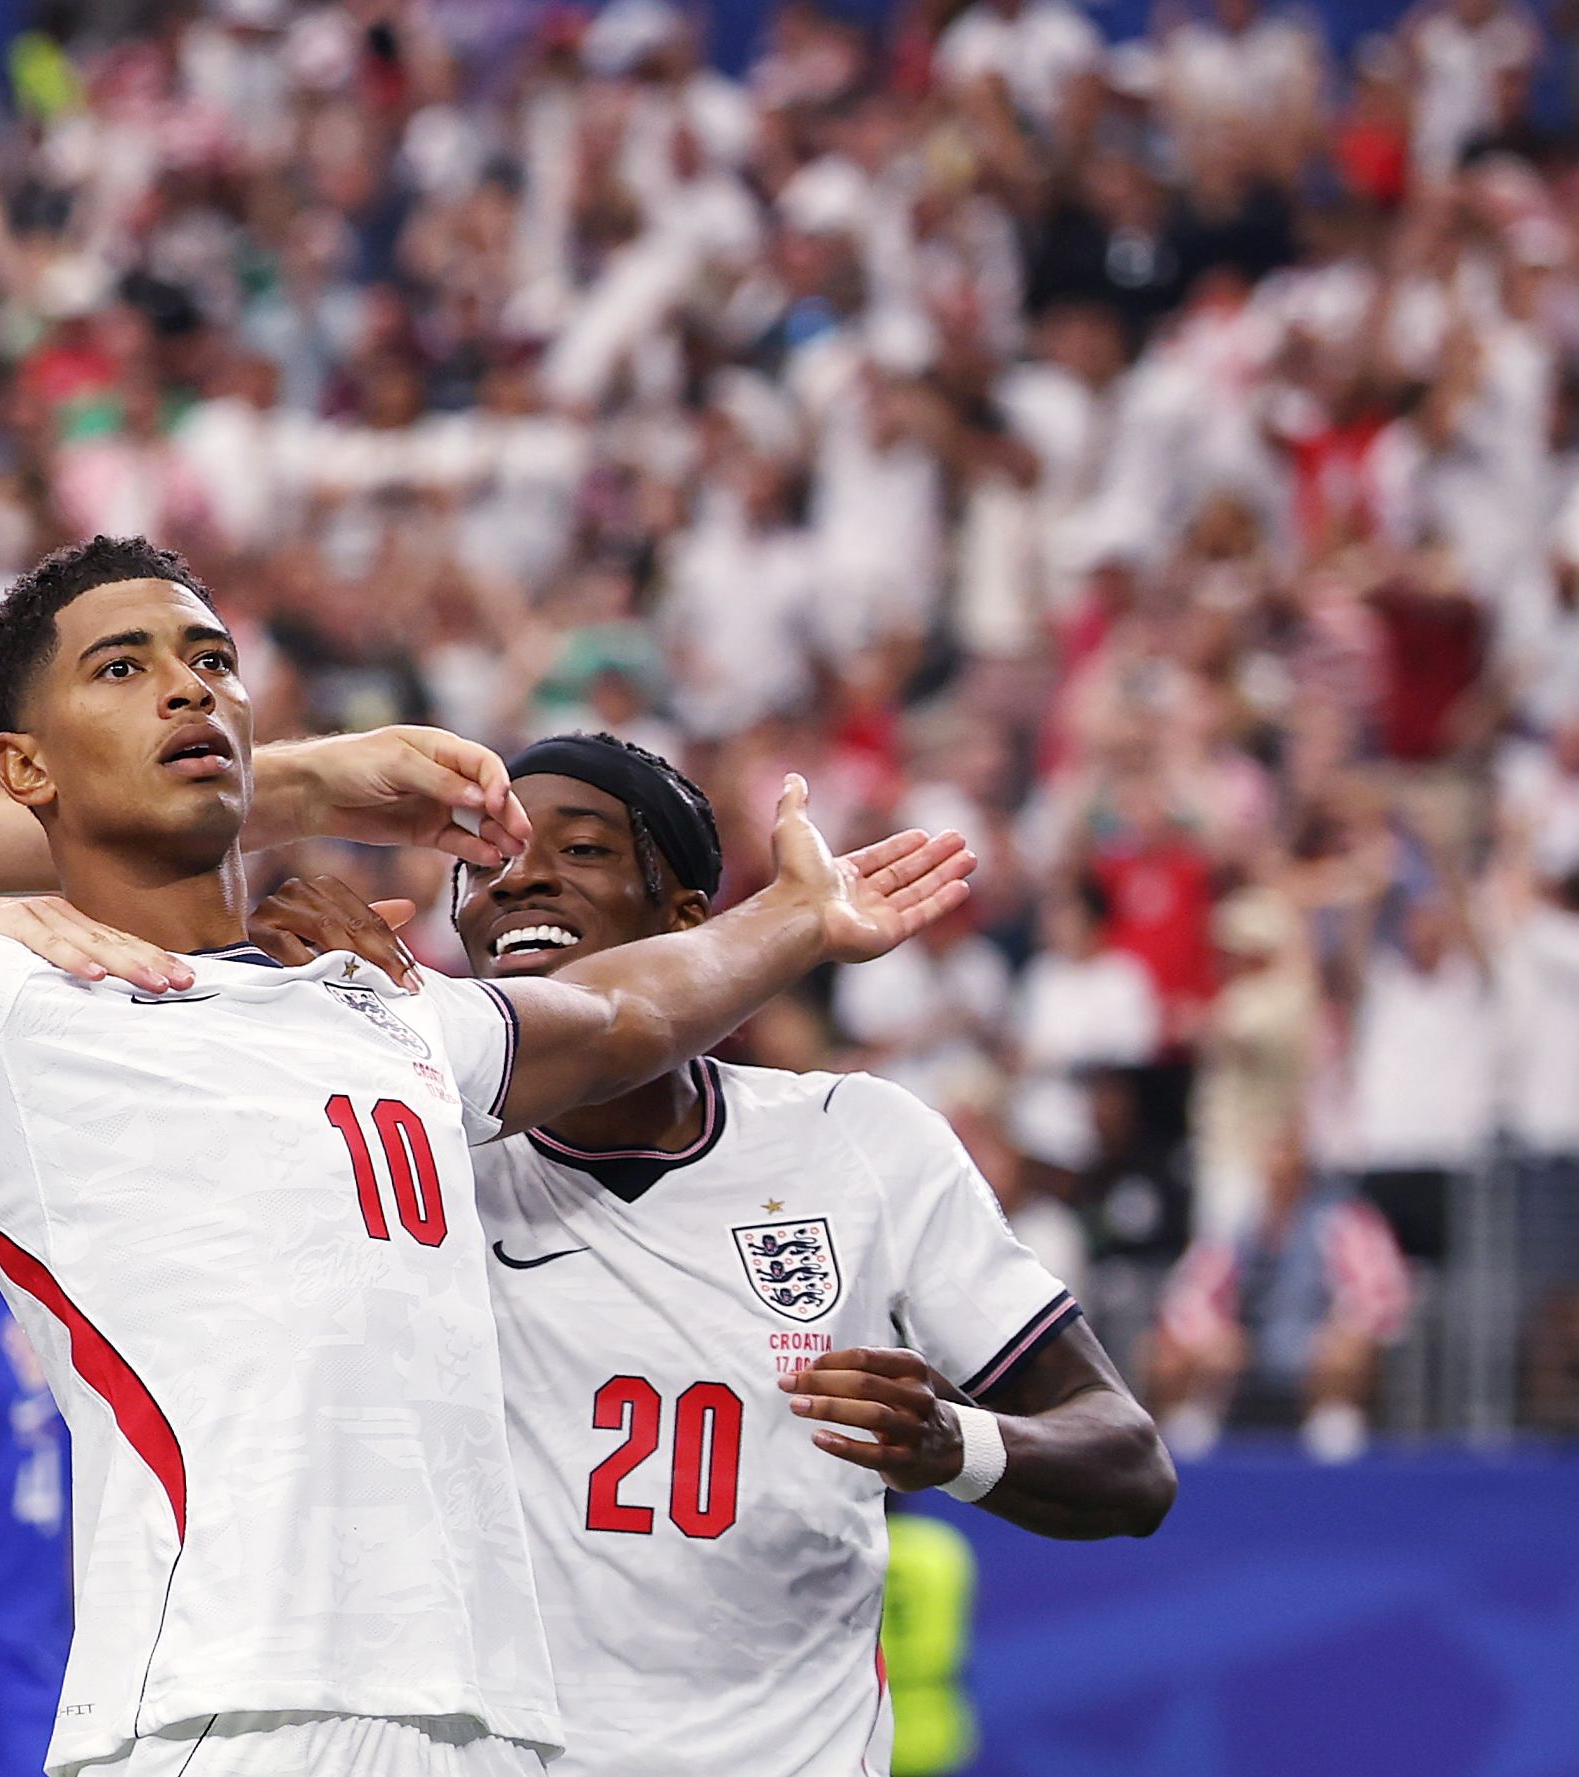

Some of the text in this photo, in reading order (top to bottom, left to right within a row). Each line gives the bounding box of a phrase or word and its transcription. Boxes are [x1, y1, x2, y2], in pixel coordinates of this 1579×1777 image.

[324, 1094, 448, 1248] 10
[769, 1333, 832, 1352] CROATIA
[586, 1374, 743, 1539] 20
[58, 1703, 95, 1718] -FIT
